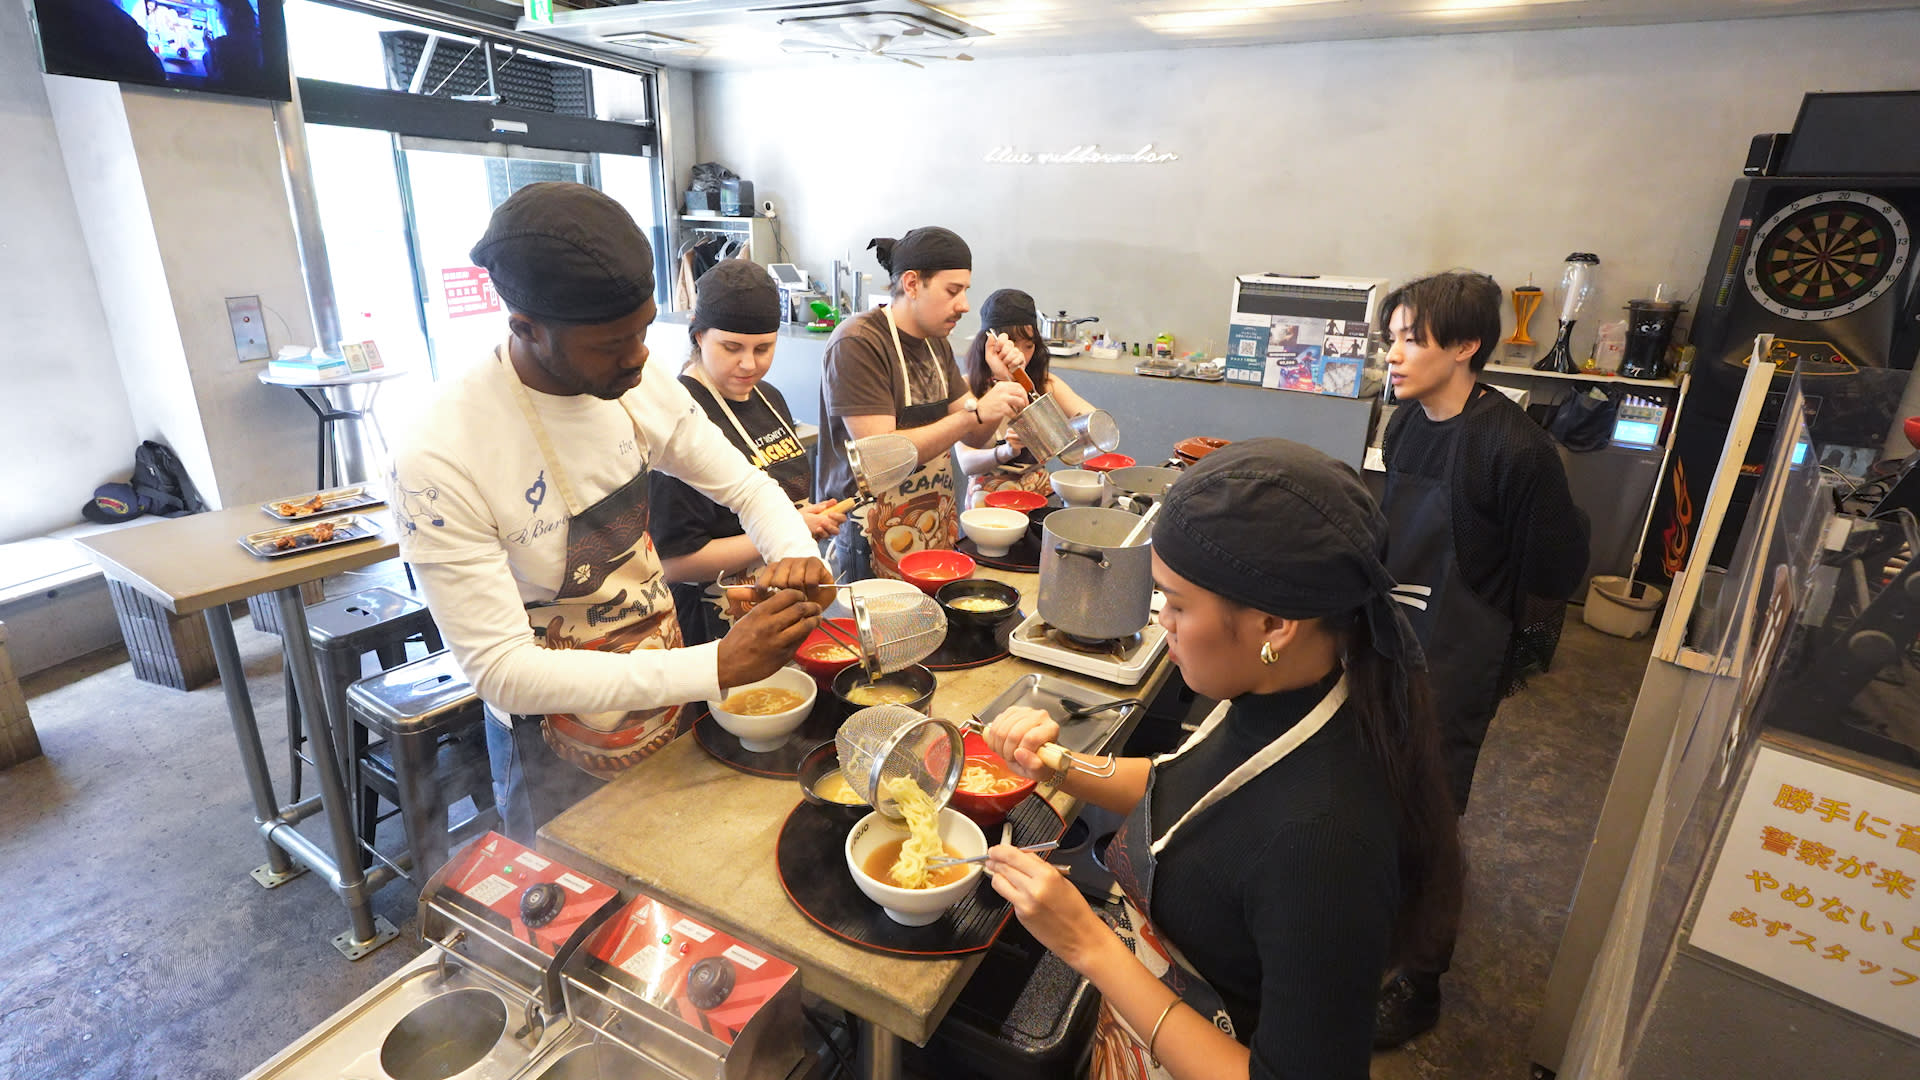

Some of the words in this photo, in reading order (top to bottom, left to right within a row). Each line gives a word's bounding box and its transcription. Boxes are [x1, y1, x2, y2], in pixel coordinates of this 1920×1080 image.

[1816, 194, 1823, 202] 5
[1838, 192, 1851, 200] 20
[1790, 203, 1800, 211] 12
[1757, 232, 1766, 240] 14
[1898, 238, 1908, 246] 13
[1896, 256, 1903, 264] 6
[1747, 268, 1754, 276] 8
[1885, 274, 1896, 282] 10
[1751, 284, 1760, 292] 16
[1869, 290, 1879, 298] 15
[1780, 307, 1789, 315] 19
[619, 439, 633, 456] the
[1760, 825, 1916, 899] 警察が来
